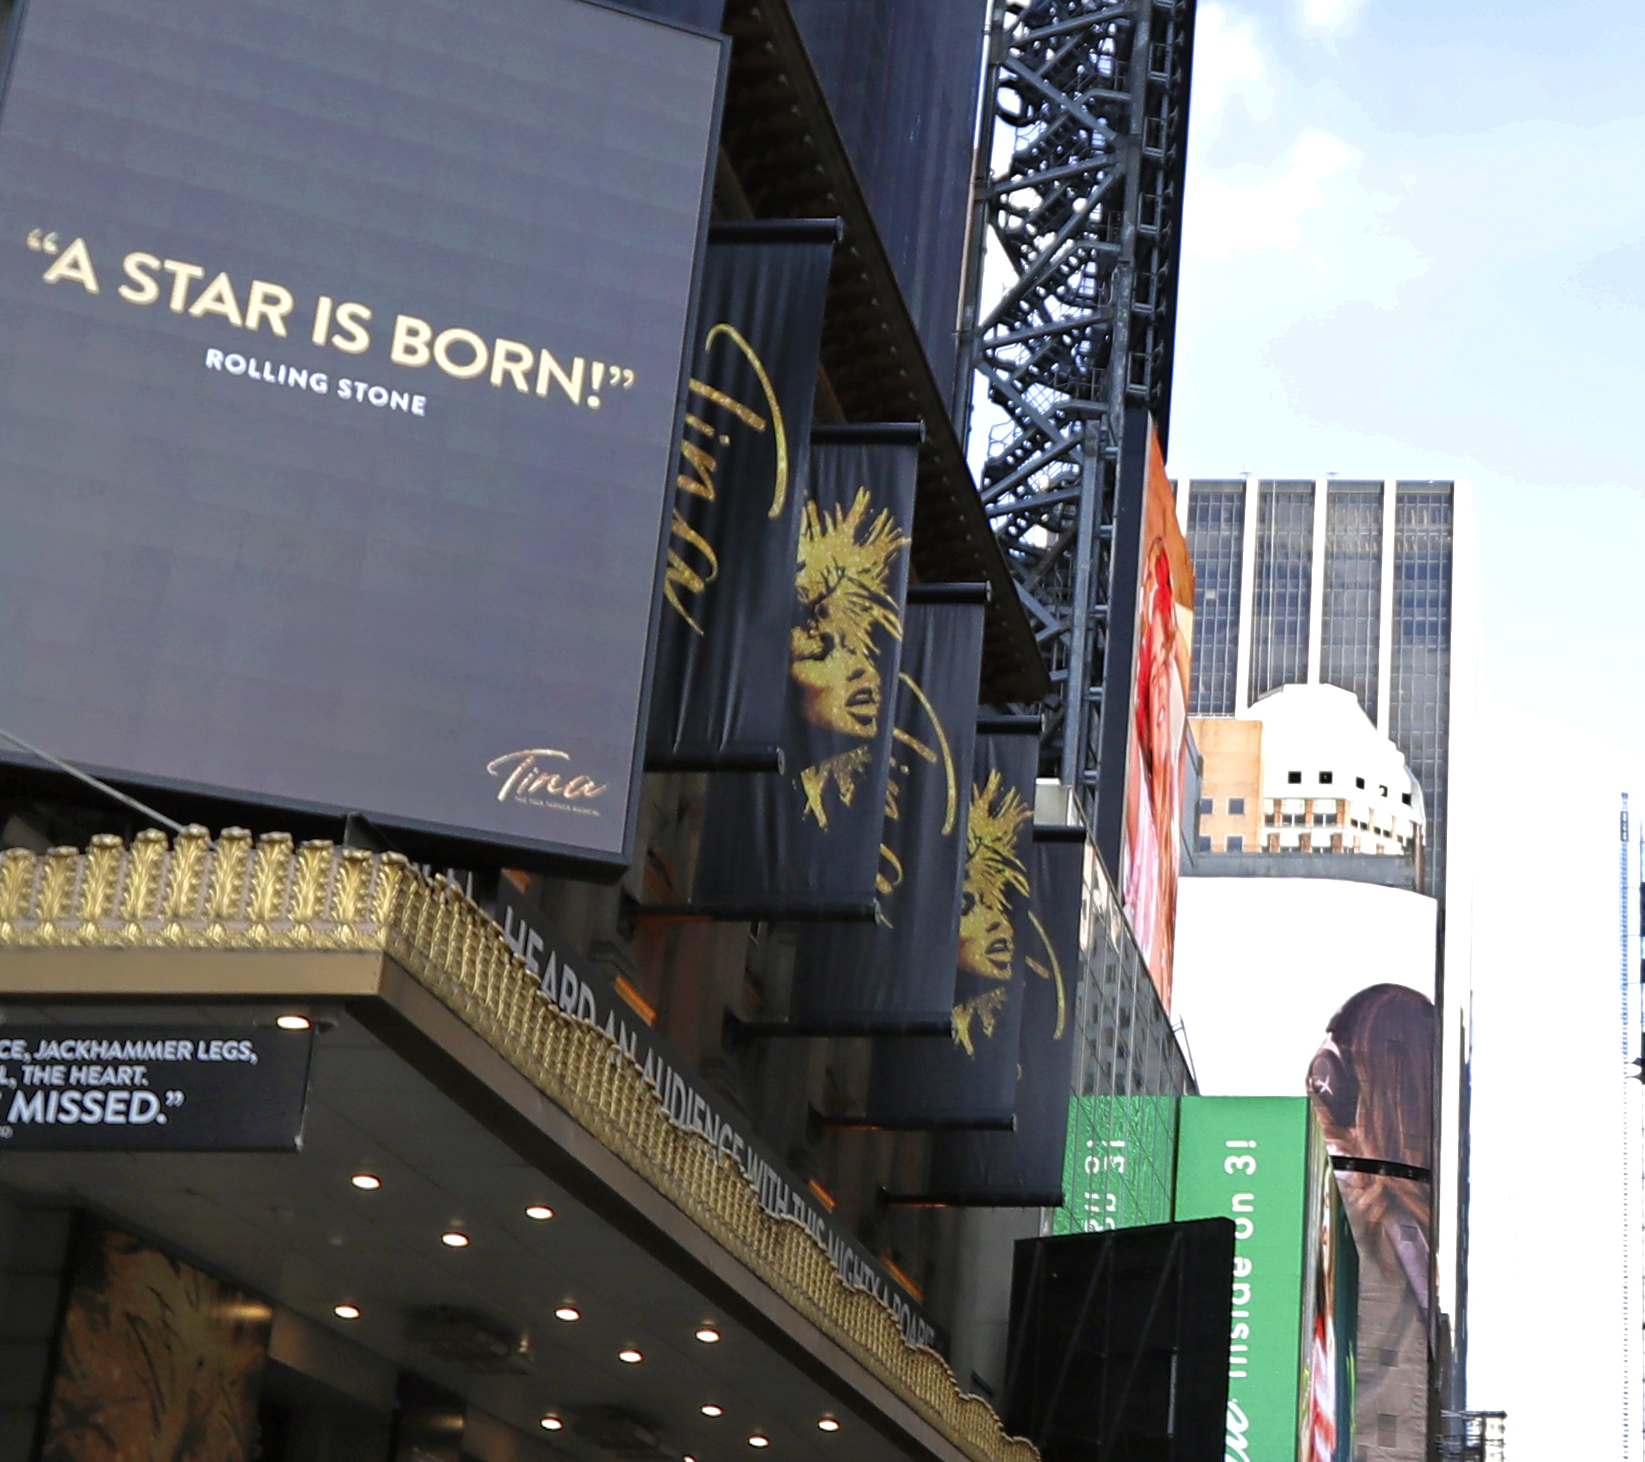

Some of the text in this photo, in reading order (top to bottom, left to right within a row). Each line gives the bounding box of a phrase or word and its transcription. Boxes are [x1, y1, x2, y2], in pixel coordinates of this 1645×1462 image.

[117, 250, 295, 338] STAR
[311, 296, 372, 355] IS
[205, 347, 427, 417] ROLLING STONE
[486, 748, 610, 804] Tina
[32, 1041, 194, 1062] JACKHAMMER
[196, 1041, 258, 1065] LEGS,
[502, 905, 597, 1029] HEARD
[640, 1049, 746, 1170] AUDIENCE
[21, 1066, 66, 1085] THE
[68, 1066, 149, 1087] HEART.
[1225, 1139, 1257, 1175] 3!
[1233, 1193, 1254, 1240] on
